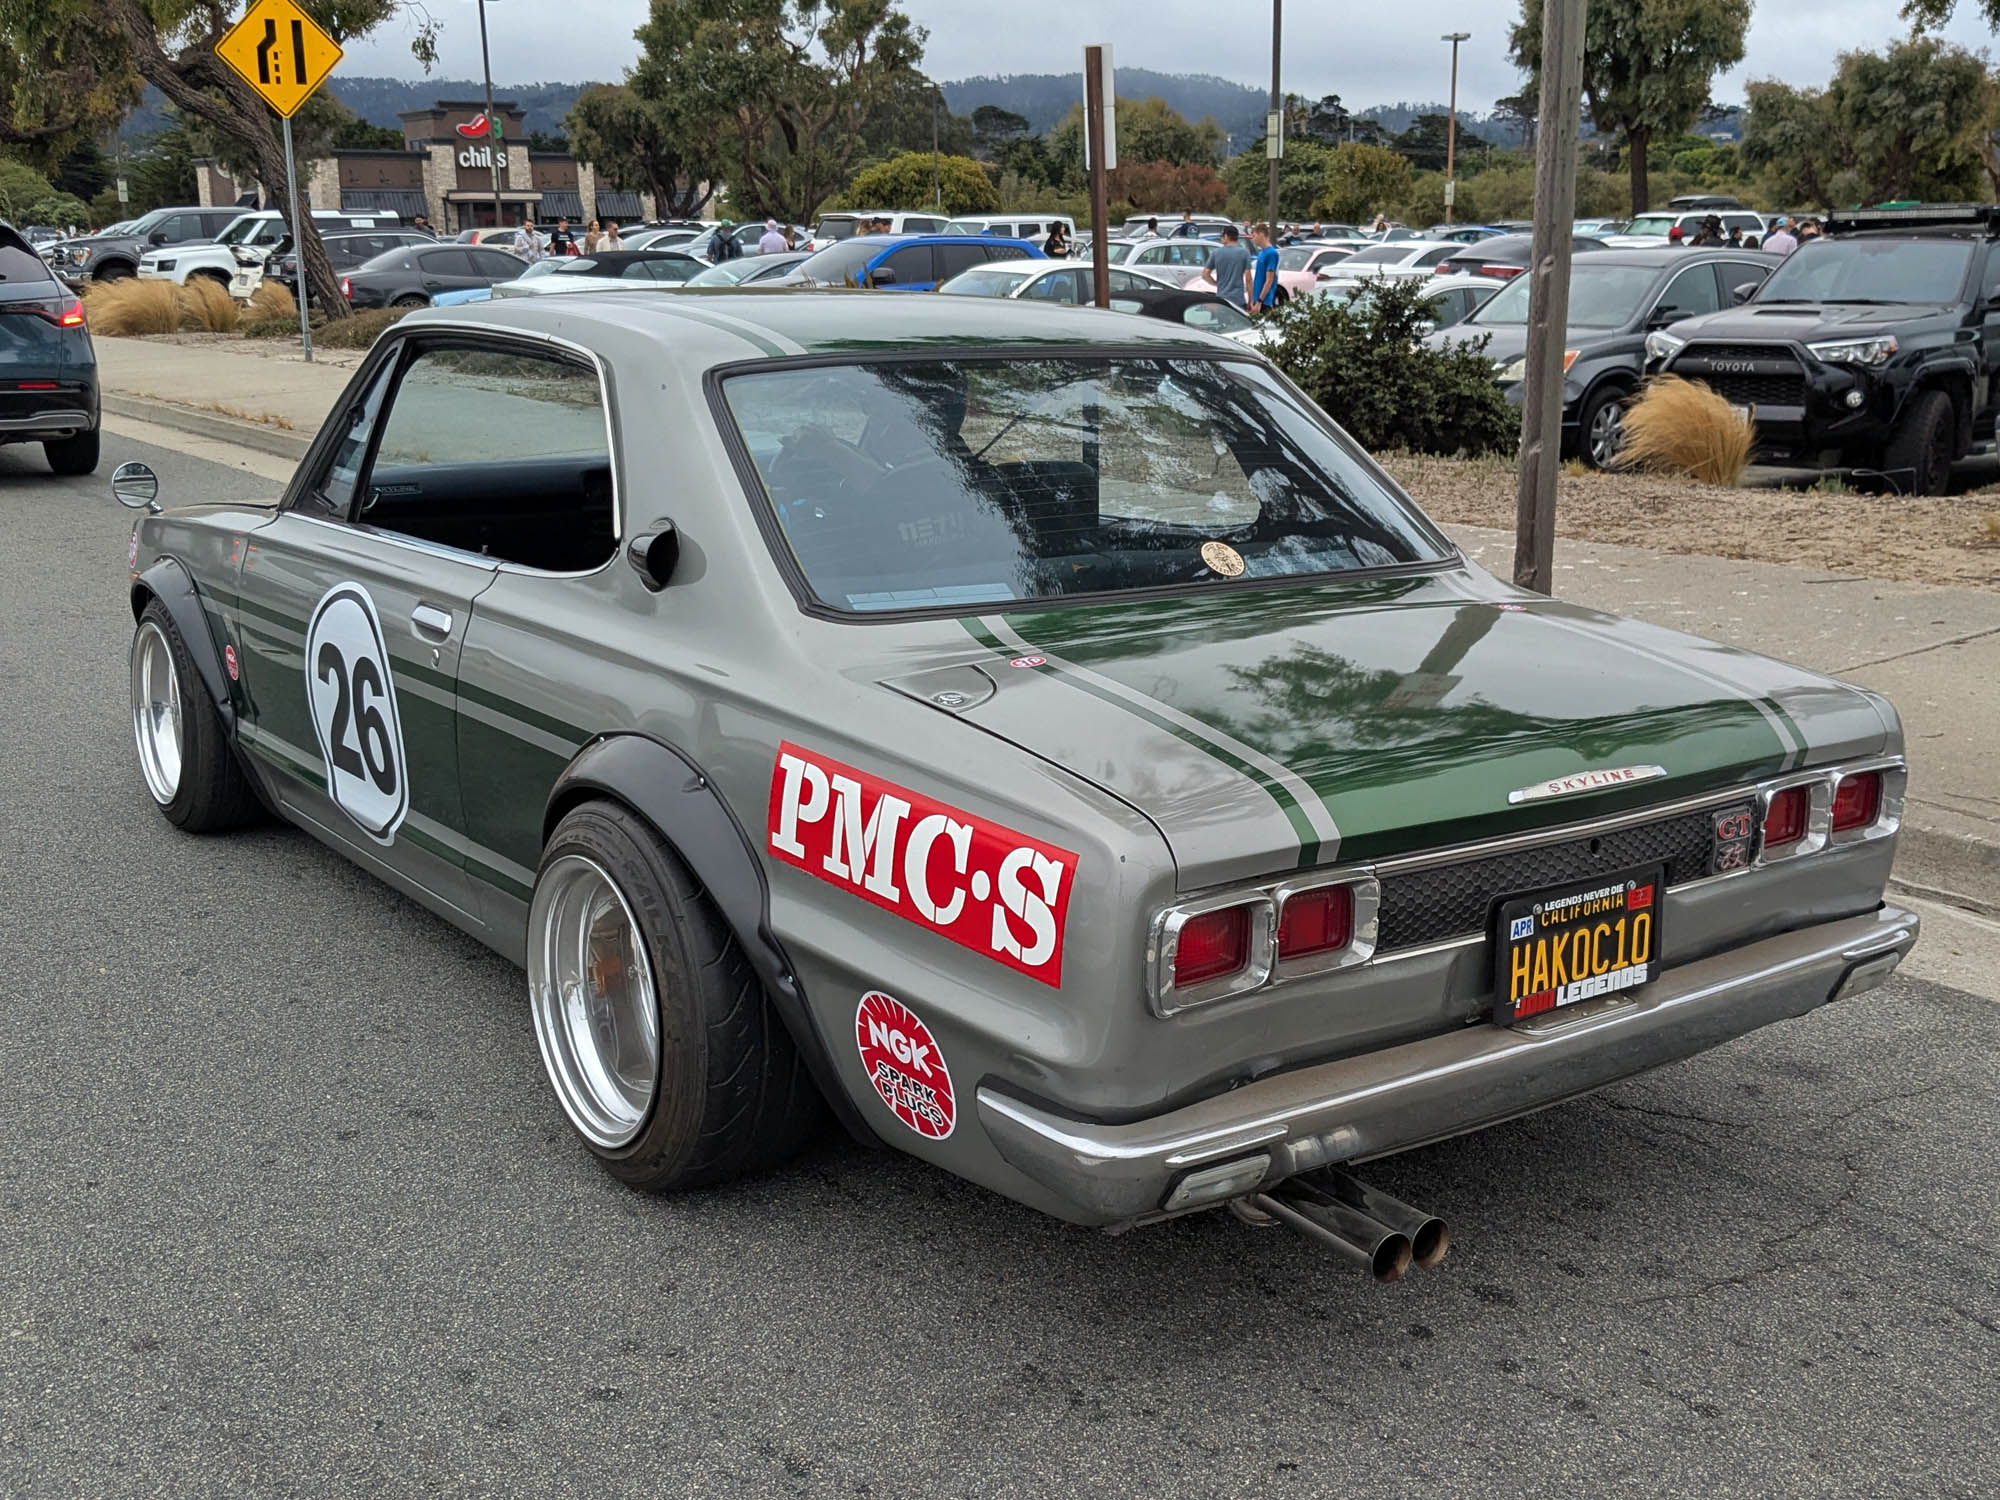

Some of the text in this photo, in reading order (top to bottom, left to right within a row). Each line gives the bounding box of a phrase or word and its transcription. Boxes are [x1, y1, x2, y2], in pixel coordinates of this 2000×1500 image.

[1711, 361, 1755, 372] TOYOTA
[318, 641, 397, 796] 26
[1549, 768, 1635, 793] SKYLINE
[1719, 813, 1751, 840] GT
[1541, 893, 1624, 927] CALIFORNIA
[1544, 883, 1624, 912] LEGENDS NEVER DIE
[1513, 918, 1533, 939] APR
[1556, 963, 1648, 1007] LEGENDS
[867, 1014, 933, 1078] NGK
[876, 1060, 937, 1105] SPARK
[881, 1080, 943, 1127] PLUGS
